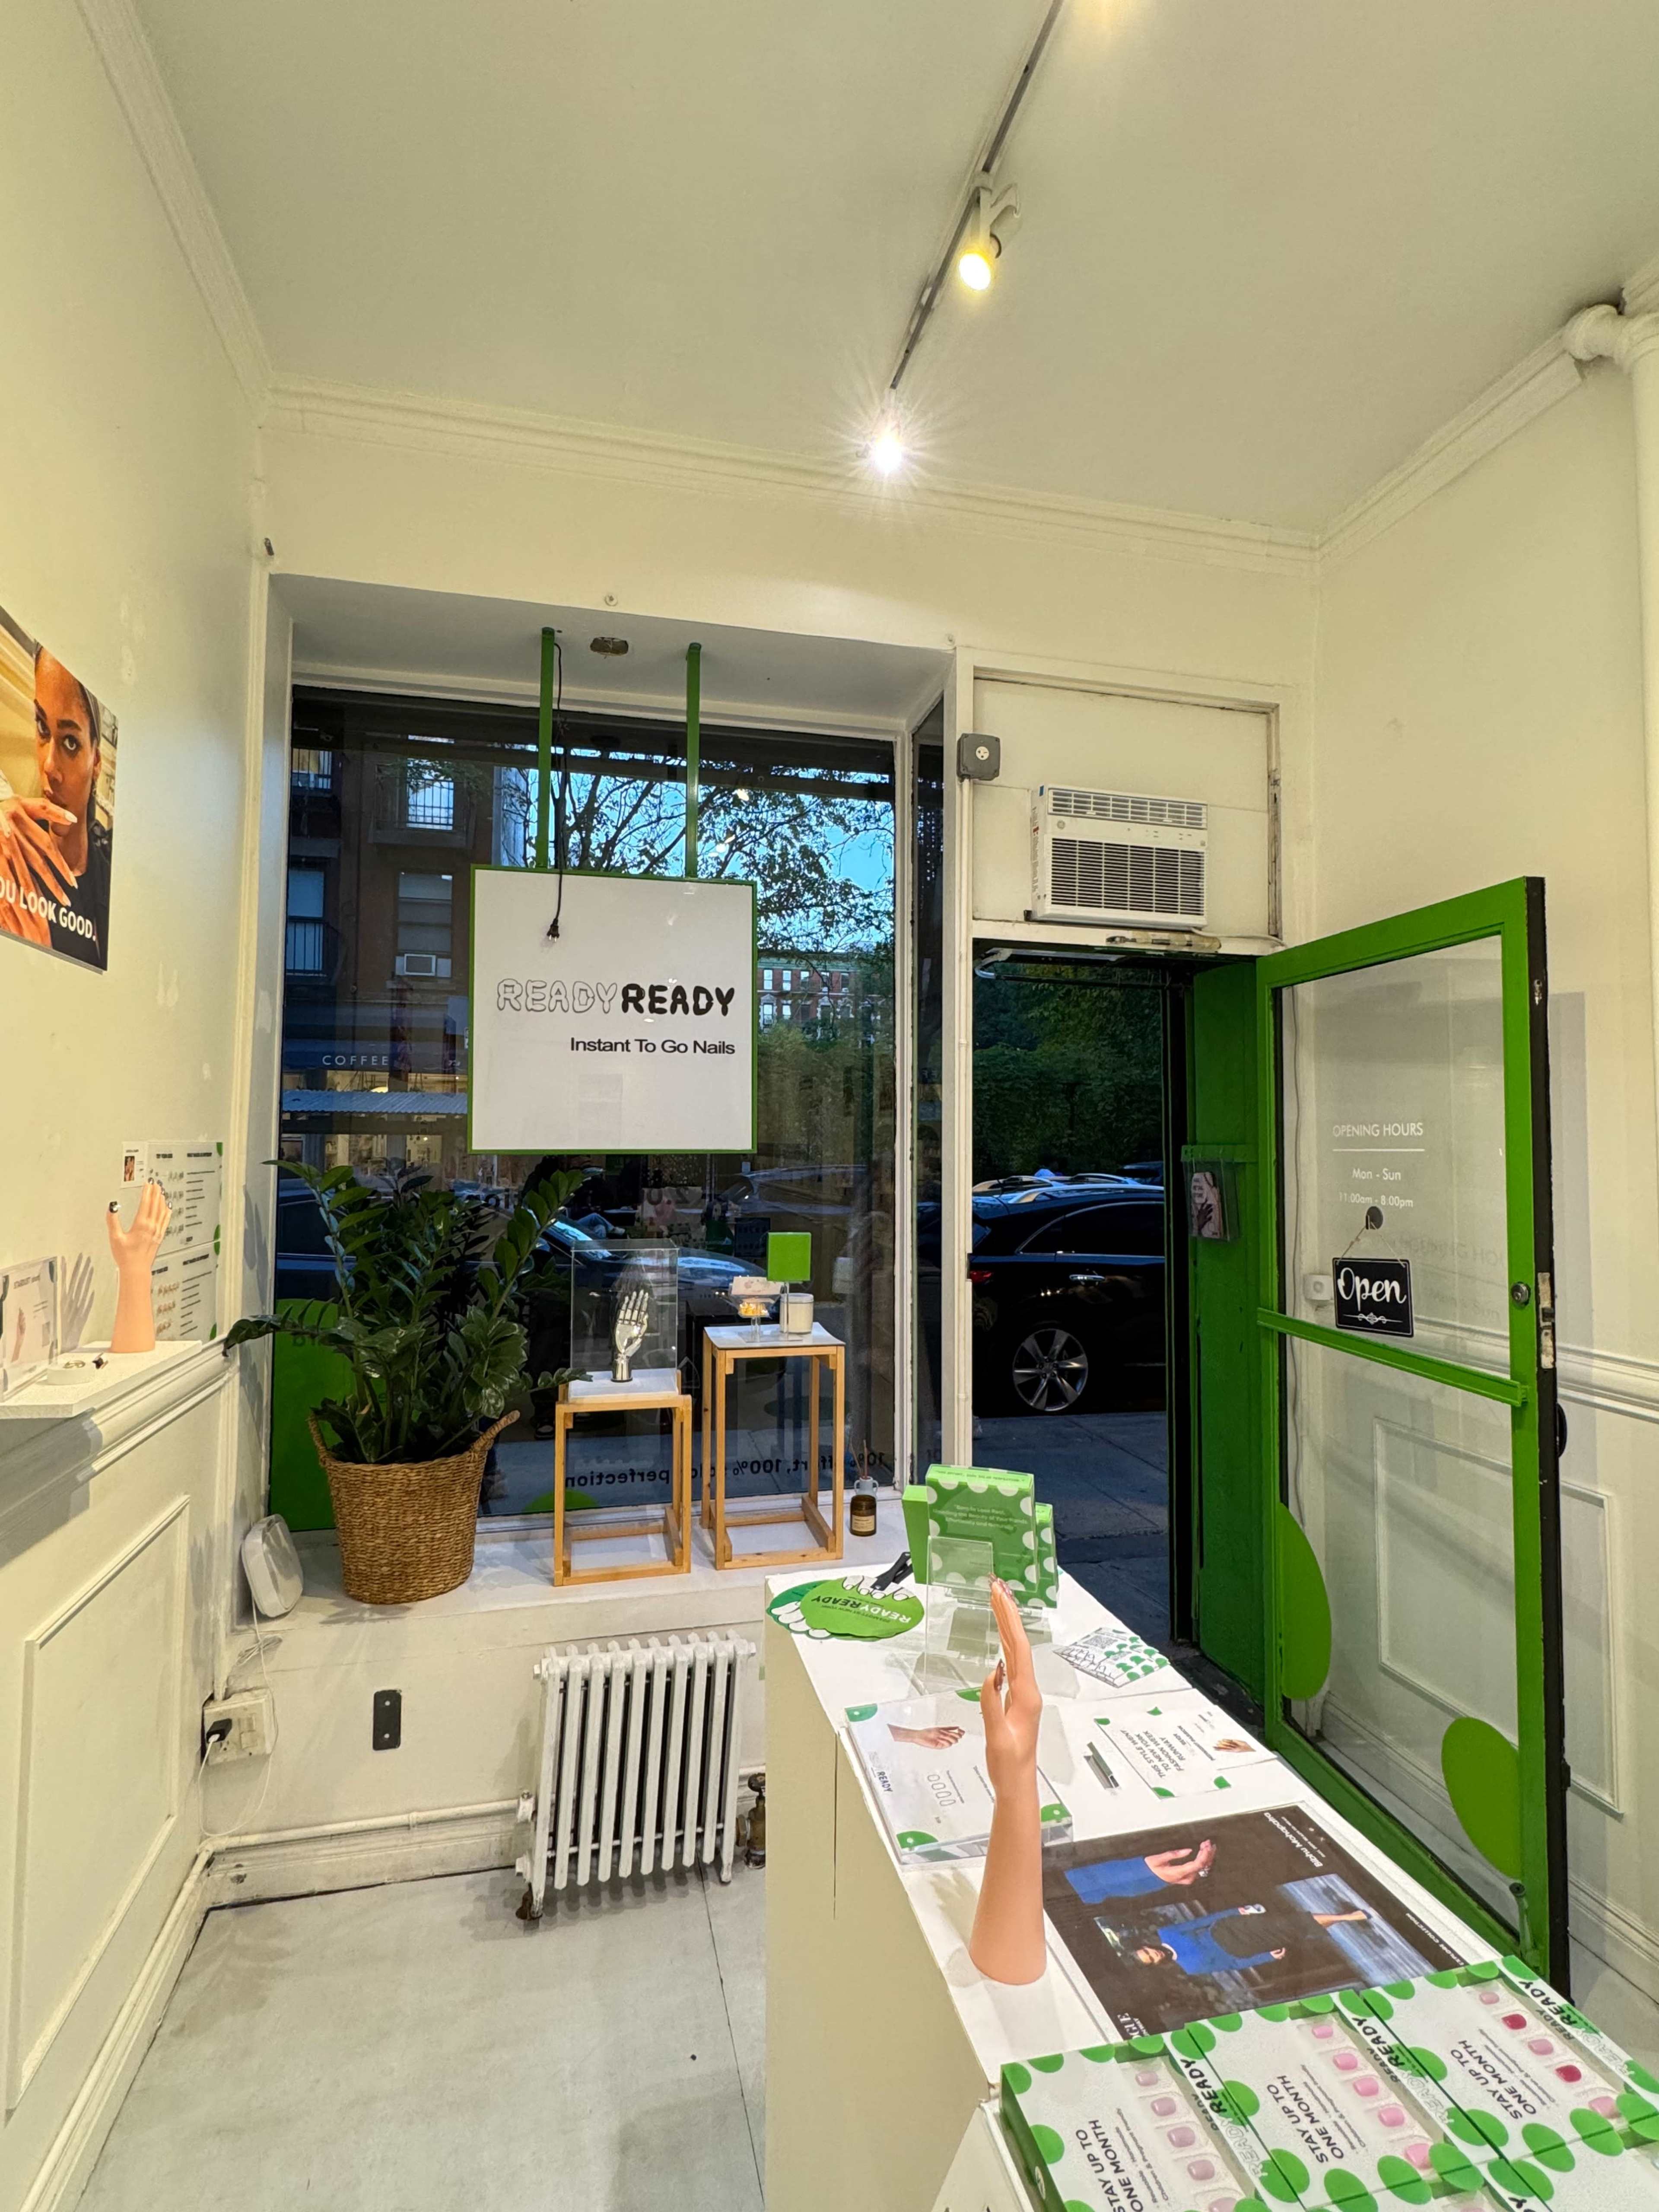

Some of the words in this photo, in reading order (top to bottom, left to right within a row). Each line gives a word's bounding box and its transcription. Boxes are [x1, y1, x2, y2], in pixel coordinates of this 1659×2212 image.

[20, 887, 57, 923] LOOK
[59, 907, 96, 941] GOOD.
[571, 1038, 630, 1052] Instant
[635, 1039, 656, 1053] To
[661, 1039, 687, 1054] Go
[693, 1041, 735, 1055] Nails
[322, 1055, 388, 1066] COFFEE
[1333, 1124, 1379, 1137] OPENING
[1383, 1122, 1424, 1136] HOURS
[1352, 1169, 1372, 1180] Mon
[1382, 1168, 1401, 1181] Sun
[1380, 1195, 1413, 1208] 8:00pm
[1337, 1267, 1406, 1311] Open
[811, 1595, 861, 1608] READY
[860, 1604, 912, 1623] READY
[1120, 1729, 1138, 1745] WENT
[1134, 1733, 1150, 1747] YORK
[1143, 1730, 1160, 1747] WEEK
[1135, 1746, 1154, 1764] STYLE
[1148, 1748, 1164, 1762] NEW
[1158, 1747, 1185, 1771] FASHION
[1159, 1737, 1185, 1761] RUNWAY
[1151, 1764, 1166, 1778] THIS
[1161, 1763, 1171, 1771] TO
[877, 1771, 893, 1792] READY
[1264, 1812, 1303, 1848] Mohapatra
[1300, 1847, 1323, 1867] Bibhu
[1406, 1913, 1439, 1943] COLLECTION
[1439, 1944, 1464, 1965] EXPLORE
[1519, 1981, 1577, 2025] READY
[1352, 2018, 1405, 2067] READY
[1451, 2050, 1469, 2067] TO
[1459, 2040, 1507, 2085] MONTH
[1180, 2059, 1227, 2113] READY
[1468, 2069, 1489, 2085] UP
[1267, 2085, 1284, 2103] TO
[1277, 2075, 1320, 2124] MONTH
[1486, 2089, 1523, 2120] STAY
[1504, 2086, 1536, 2114] ONE
[1282, 2106, 1301, 2124] UP
[1076, 2129, 1092, 2150] TO
[1088, 2120, 1125, 2174] MONTH
[1297, 2129, 1328, 2163] STAY
[1315, 2126, 1344, 2159] ONE
[1087, 2153, 1105, 2174] UP
[1118, 2177, 1143, 2212] ONE
